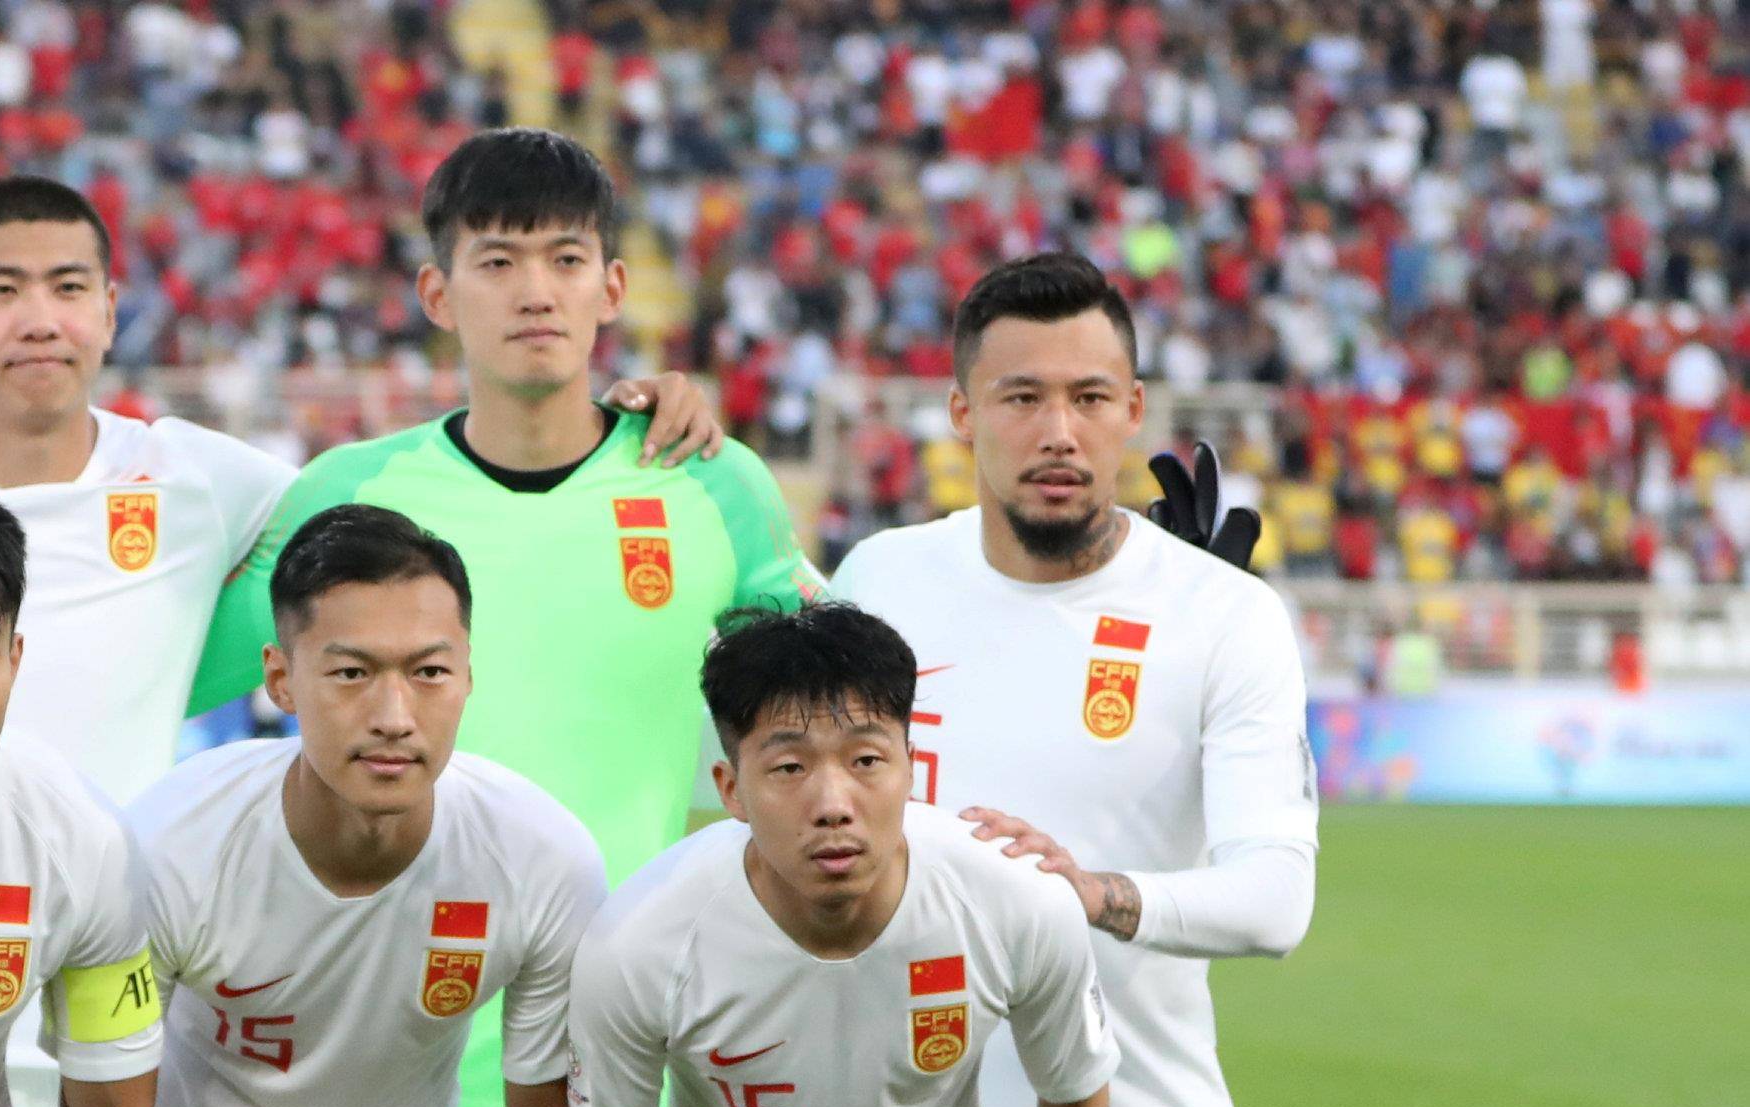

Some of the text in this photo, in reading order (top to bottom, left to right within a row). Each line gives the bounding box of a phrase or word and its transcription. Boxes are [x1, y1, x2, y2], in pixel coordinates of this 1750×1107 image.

[108, 496, 154, 513] CFA
[1091, 661, 1137, 681] CFA
[431, 953, 479, 969] CFA
[914, 1008, 964, 1028] CFA
[211, 1005, 295, 1074] 15
